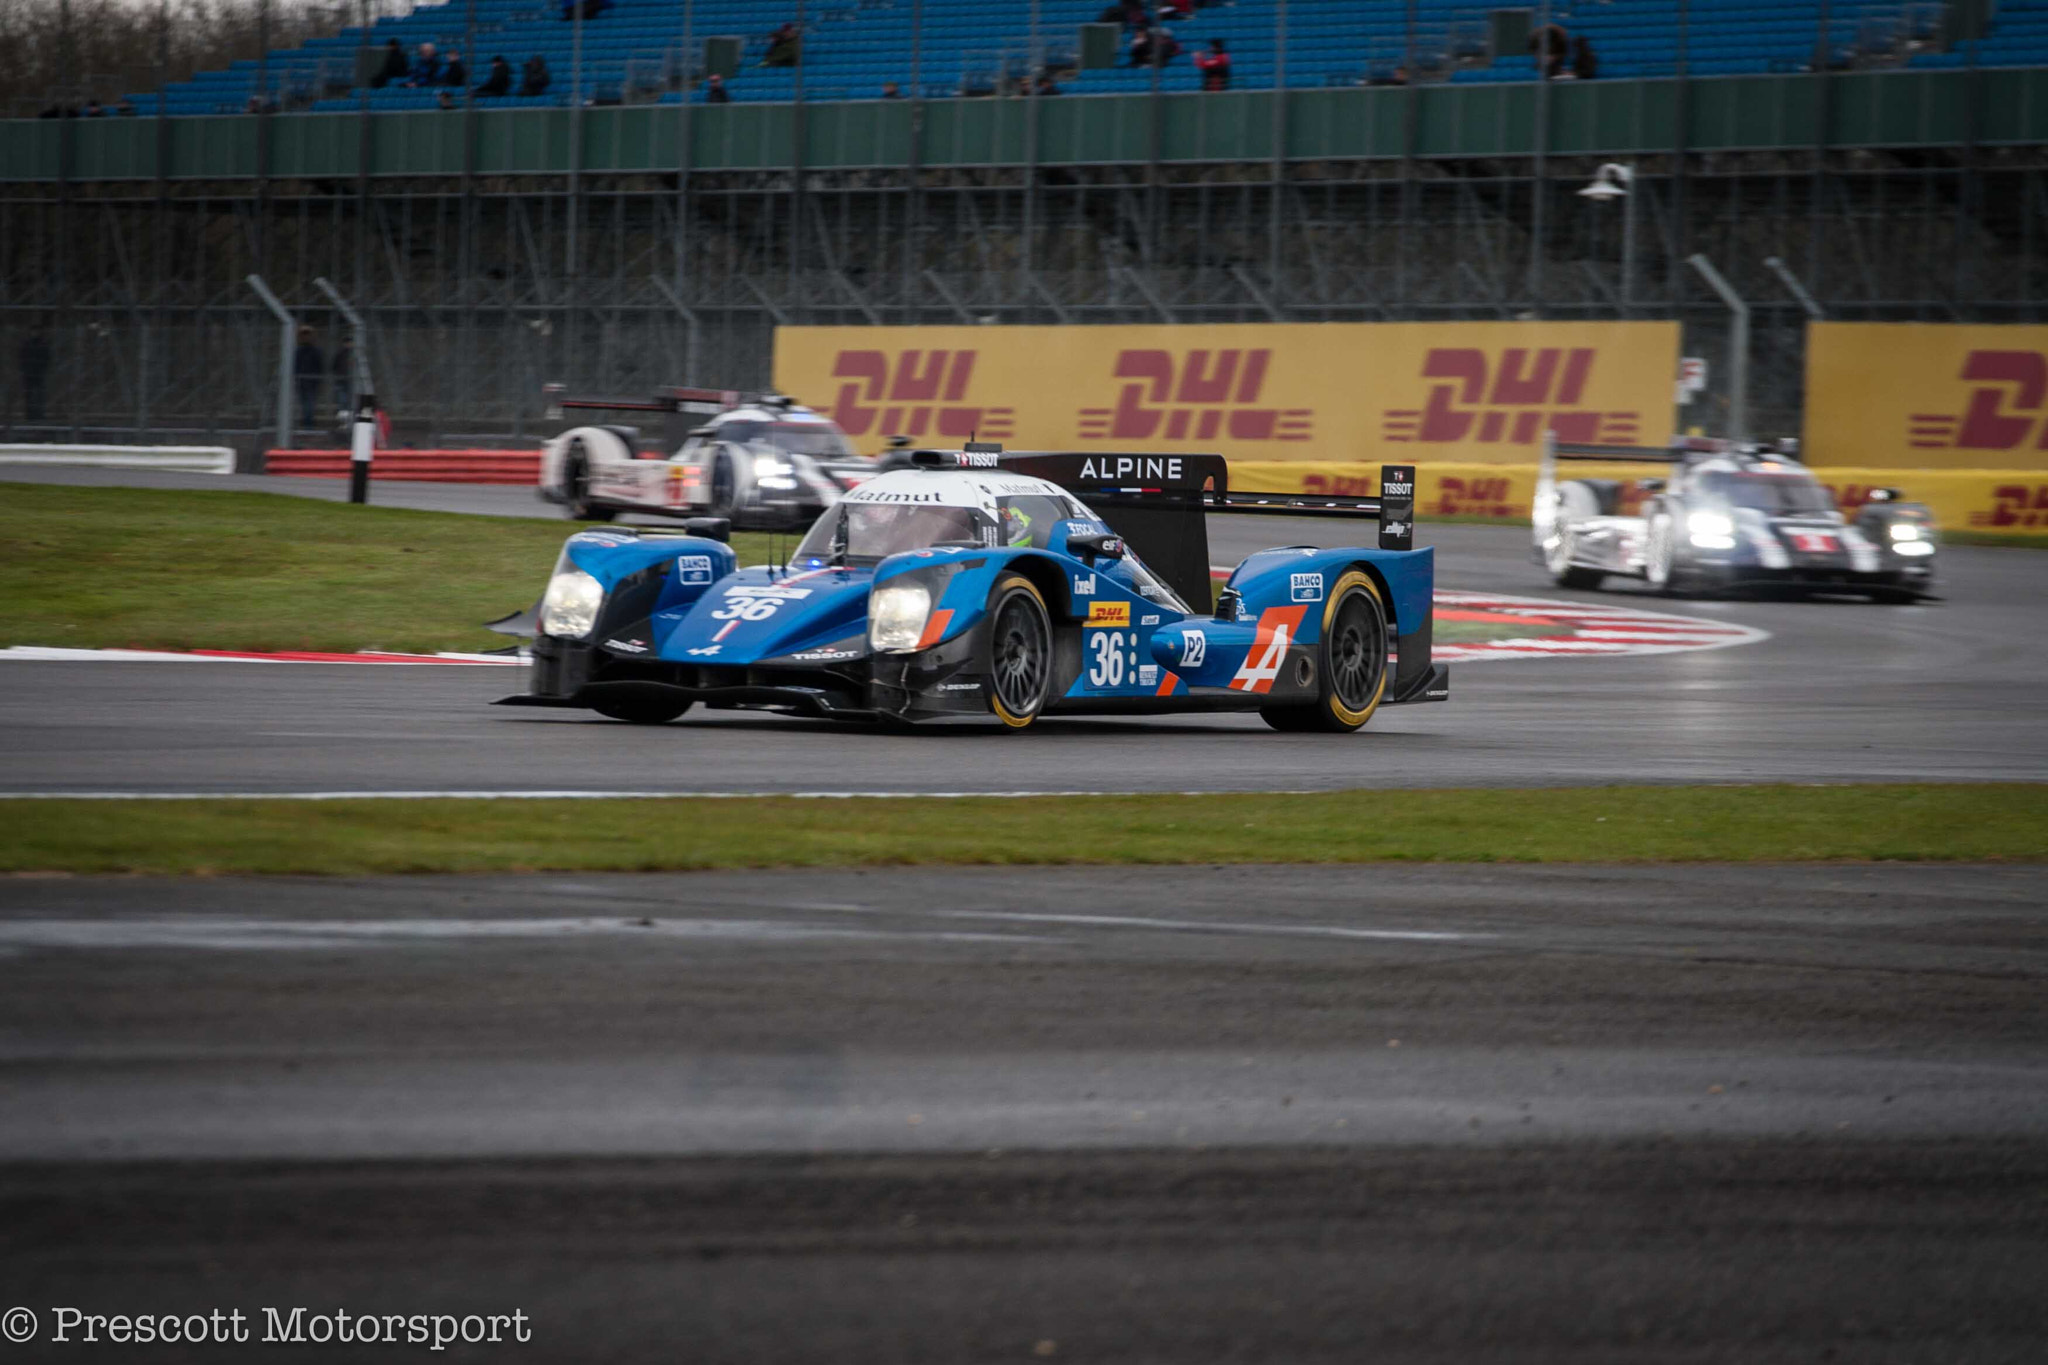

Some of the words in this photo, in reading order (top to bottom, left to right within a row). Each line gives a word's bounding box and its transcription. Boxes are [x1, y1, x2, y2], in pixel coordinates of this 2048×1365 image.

[831, 349, 984, 437] DHL
[1110, 349, 1280, 440] DHL
[1419, 348, 1600, 444] DHL
[968, 453, 999, 467] TISSOT
[1080, 458, 1182, 479] ALPINE
[1383, 483, 1413, 495] TISSOT
[1102, 540, 1116, 551] elf
[1293, 576, 1320, 586] BAHCO
[711, 597, 785, 621] 36
[1095, 607, 1124, 621] DHL
[791, 650, 860, 660] TISSOT
[1090, 631, 1124, 686] 36
[1184, 636, 1204, 663] P2
